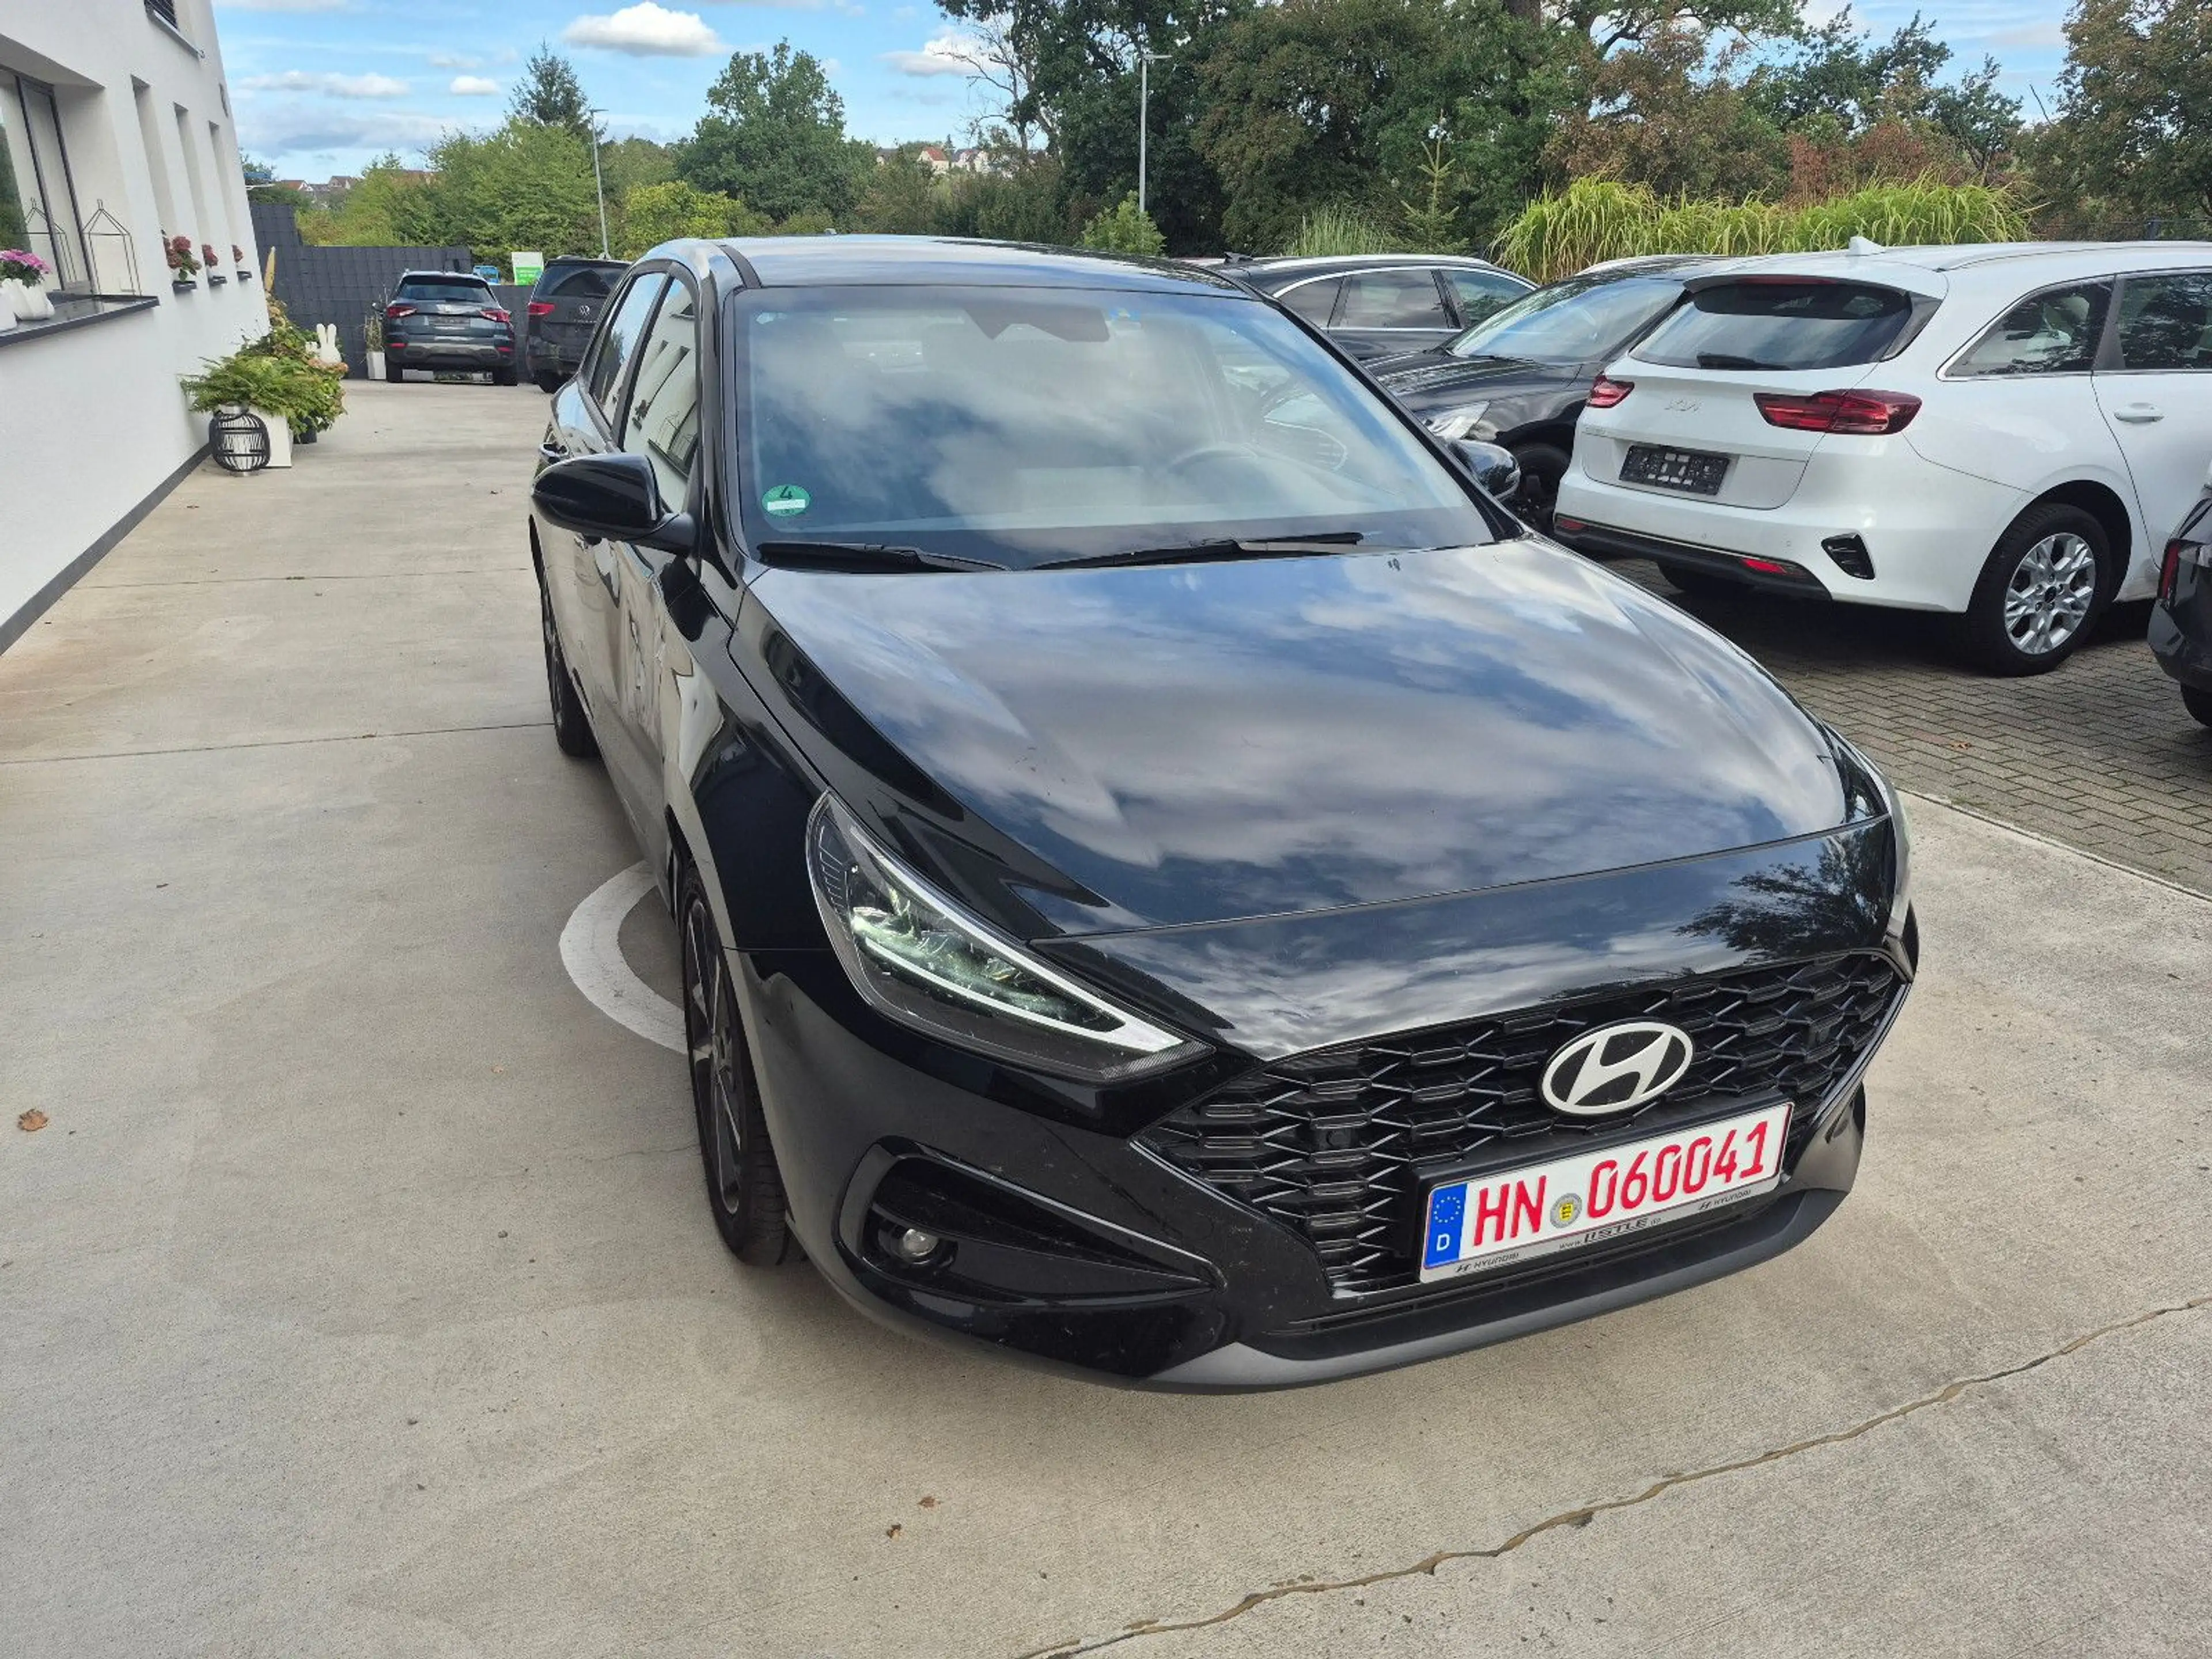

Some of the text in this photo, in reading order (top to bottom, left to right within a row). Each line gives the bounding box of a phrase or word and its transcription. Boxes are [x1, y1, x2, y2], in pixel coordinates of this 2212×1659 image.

[779, 486, 793, 499] 4
[1473, 1120, 1768, 1247] HN 060041
[1436, 1233, 1450, 1252] D
